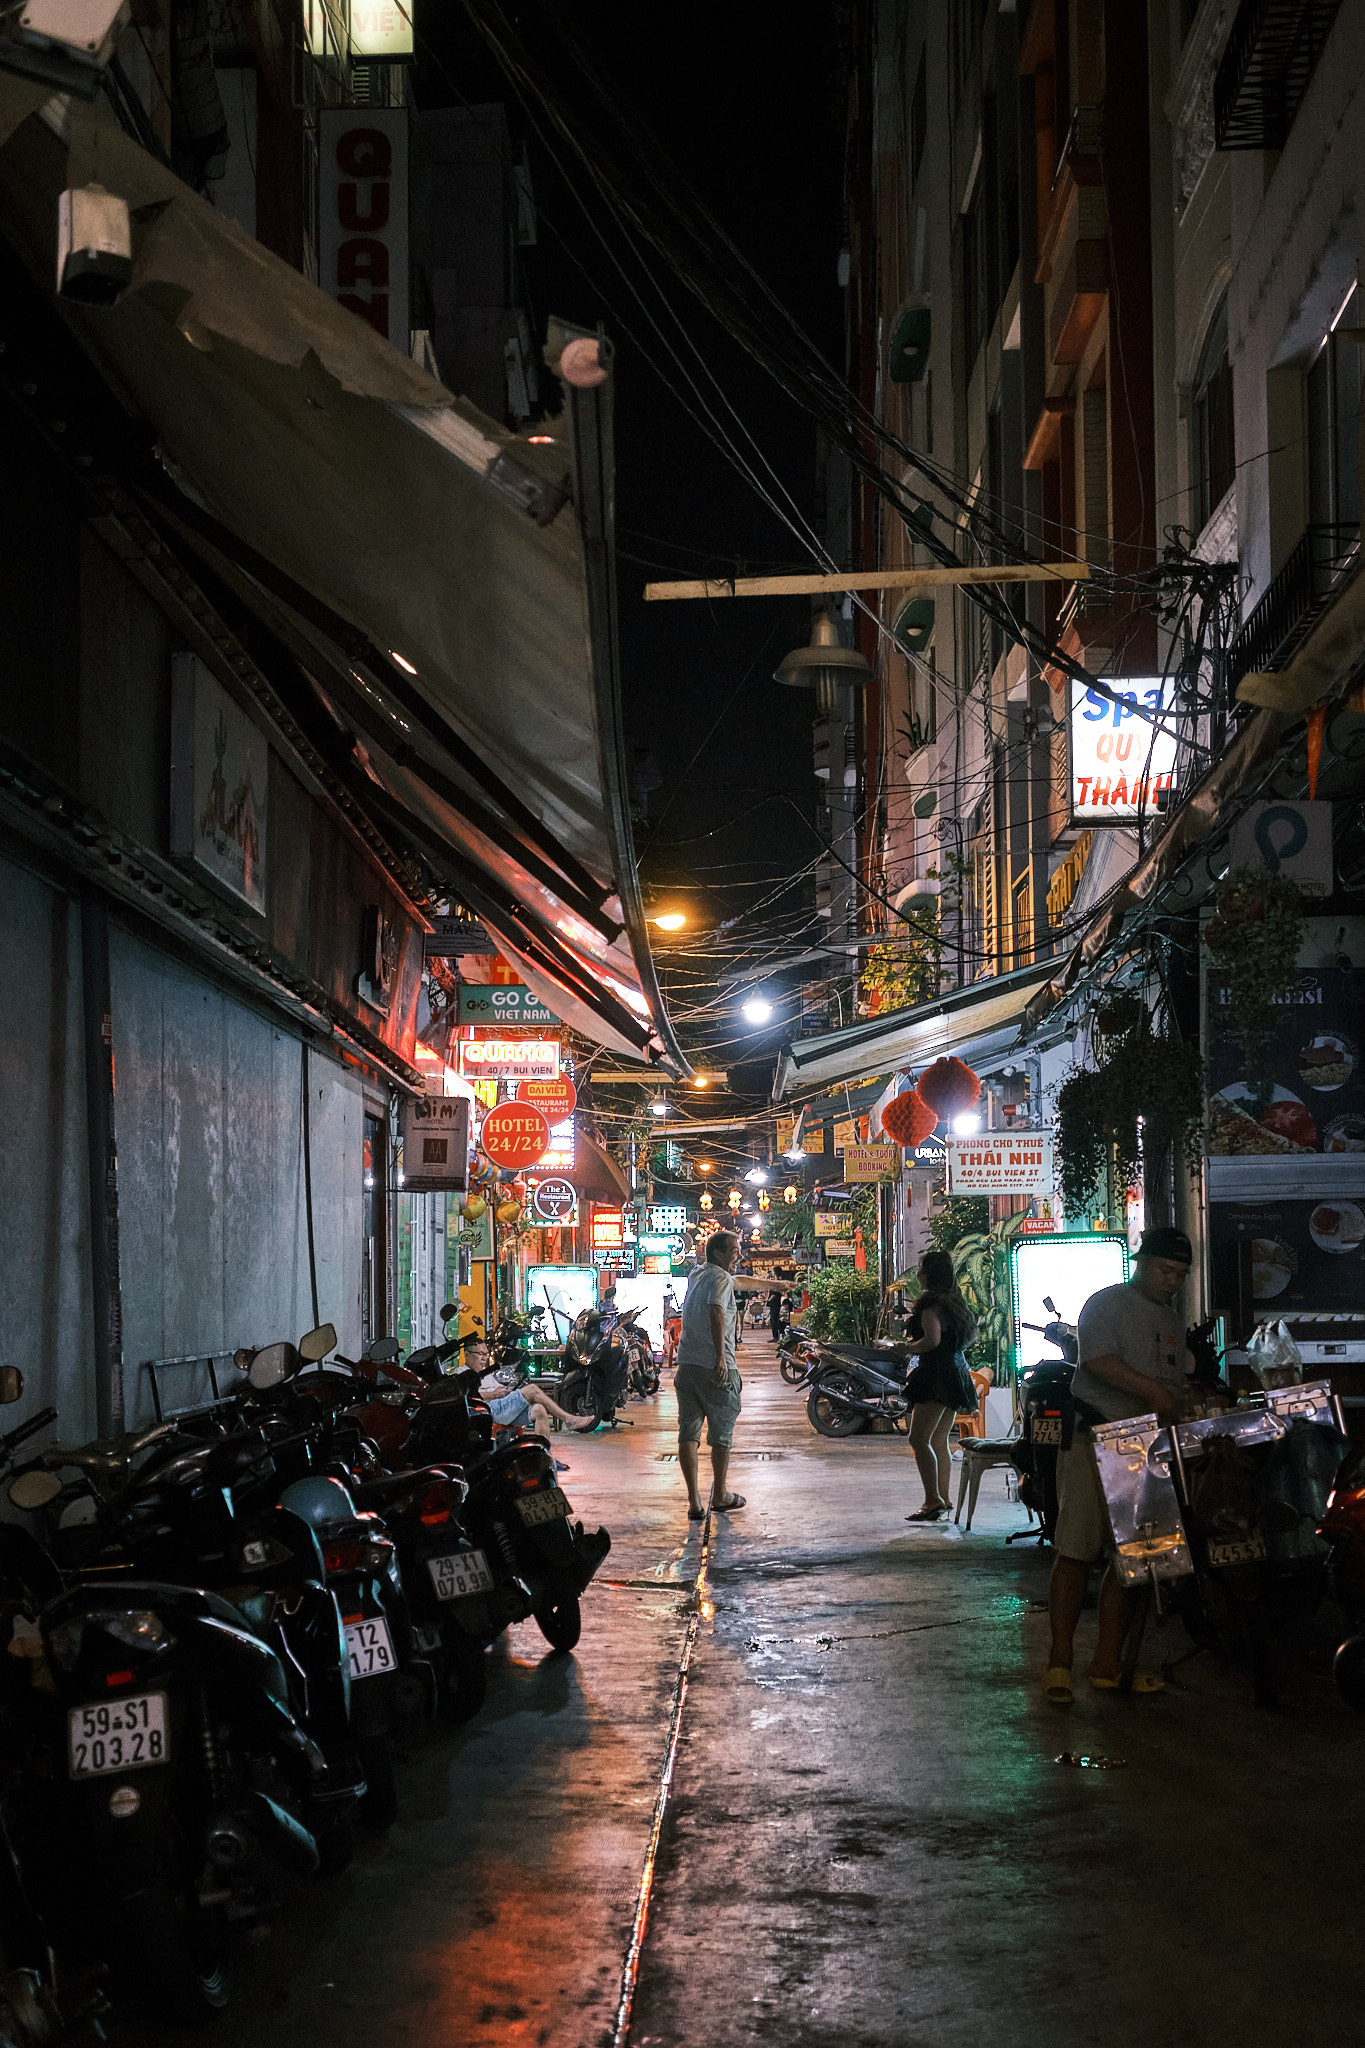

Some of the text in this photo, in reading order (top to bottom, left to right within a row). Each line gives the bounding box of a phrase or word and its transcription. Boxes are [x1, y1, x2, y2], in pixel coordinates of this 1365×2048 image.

[1082, 681, 1165, 727] Spa
[1096, 733, 1143, 763] QU
[491, 991, 546, 1006] GO G
[494, 1009, 551, 1020] VIET NAM
[487, 1066, 510, 1074] 40/7
[514, 1066, 528, 1074] BUI
[532, 1066, 553, 1074] VIEN
[488, 1117, 545, 1133] HOTEL
[488, 1135, 544, 1153] 24/24
[784, 1136, 817, 1144] HEL
[993, 1139, 1012, 1148] CHO
[1015, 1137, 1044, 1148] THUÊ
[848, 1149, 868, 1159] HOTEL
[957, 1150, 1002, 1165] THÁI
[1009, 1152, 1042, 1165] NHI
[858, 1162, 887, 1171] BOOKING
[986, 1169, 1001, 1177] BUI
[1004, 1168, 1025, 1177] VIEN
[545, 1185, 567, 1193] The 1
[593, 1223, 622, 1241] HOTEL
[436, 1553, 478, 1577] 29-X1
[82, 1699, 149, 1738] 59-S1
[75, 1729, 163, 1773] 203.28
